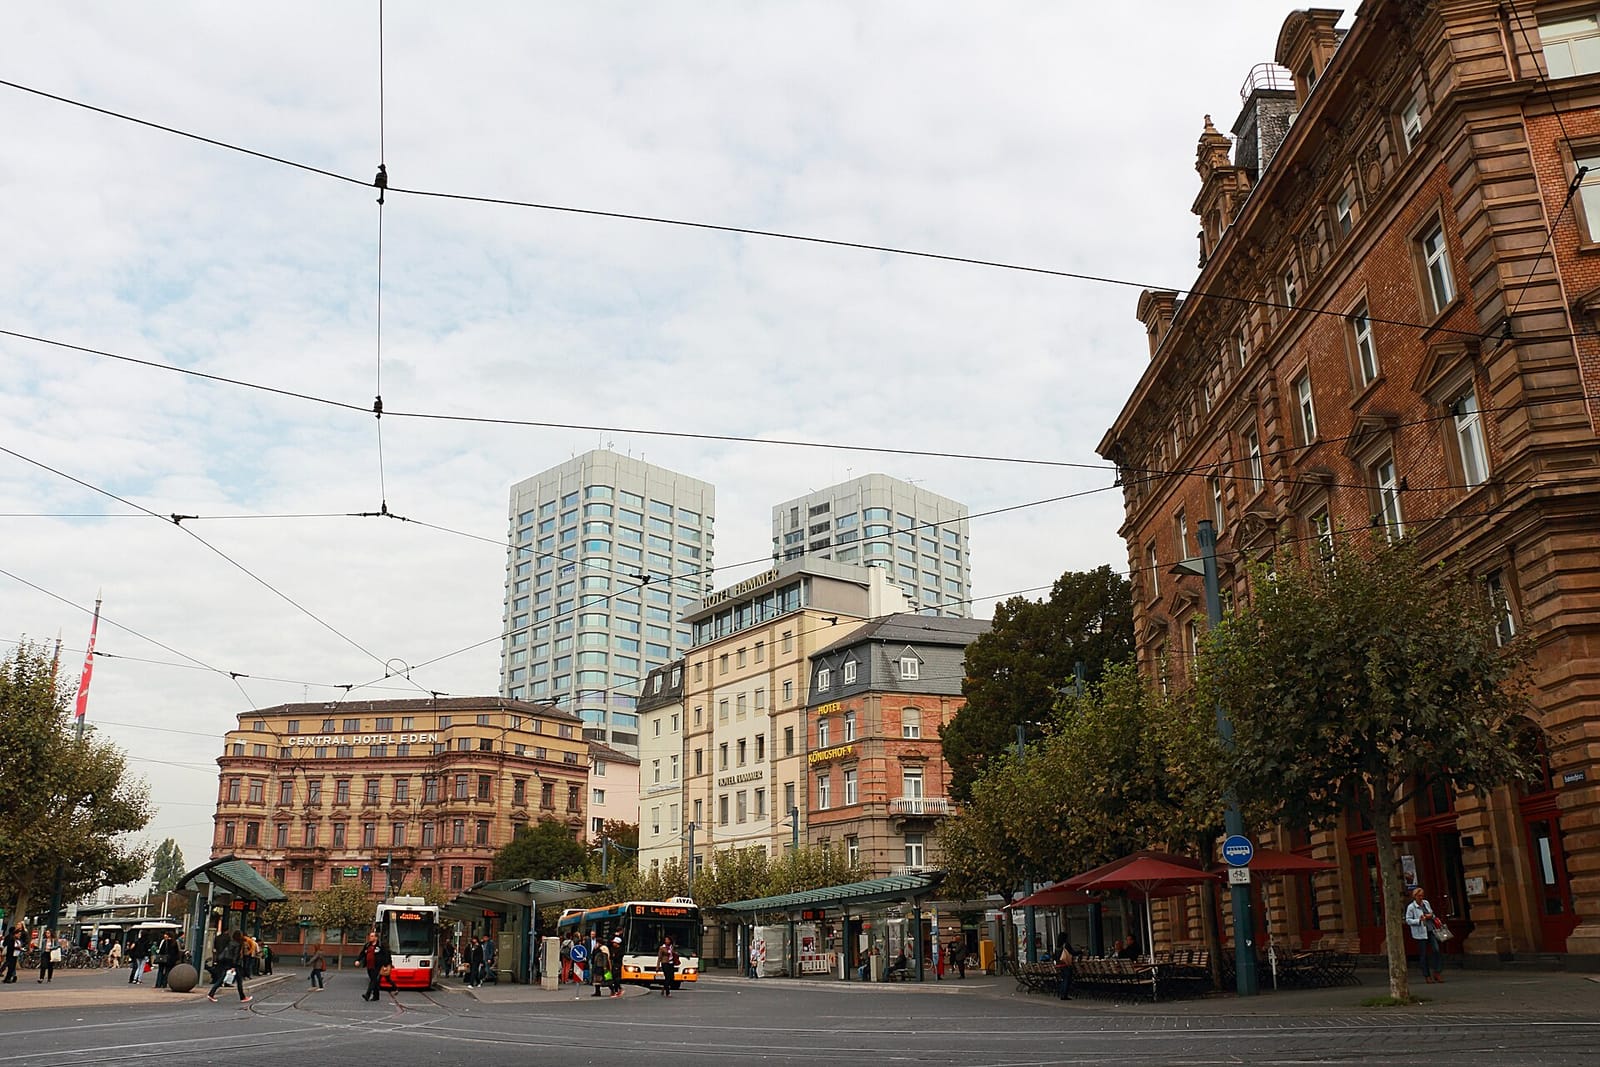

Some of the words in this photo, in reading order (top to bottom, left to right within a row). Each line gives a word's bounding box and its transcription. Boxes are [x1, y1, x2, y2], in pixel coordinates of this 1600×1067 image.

[702, 588, 729, 609] HOTEL
[735, 568, 779, 595] HAMMER
[817, 702, 842, 715] HOTEL
[288, 736, 348, 746] CENTRAL
[352, 734, 396, 744] HOTEL
[400, 733, 438, 743] EDEN
[808, 747, 847, 763] KÖNIGSHOF
[718, 776, 736, 787] HOTEL
[736, 770, 763, 783] HAMMER
[635, 906, 645, 915] 61
